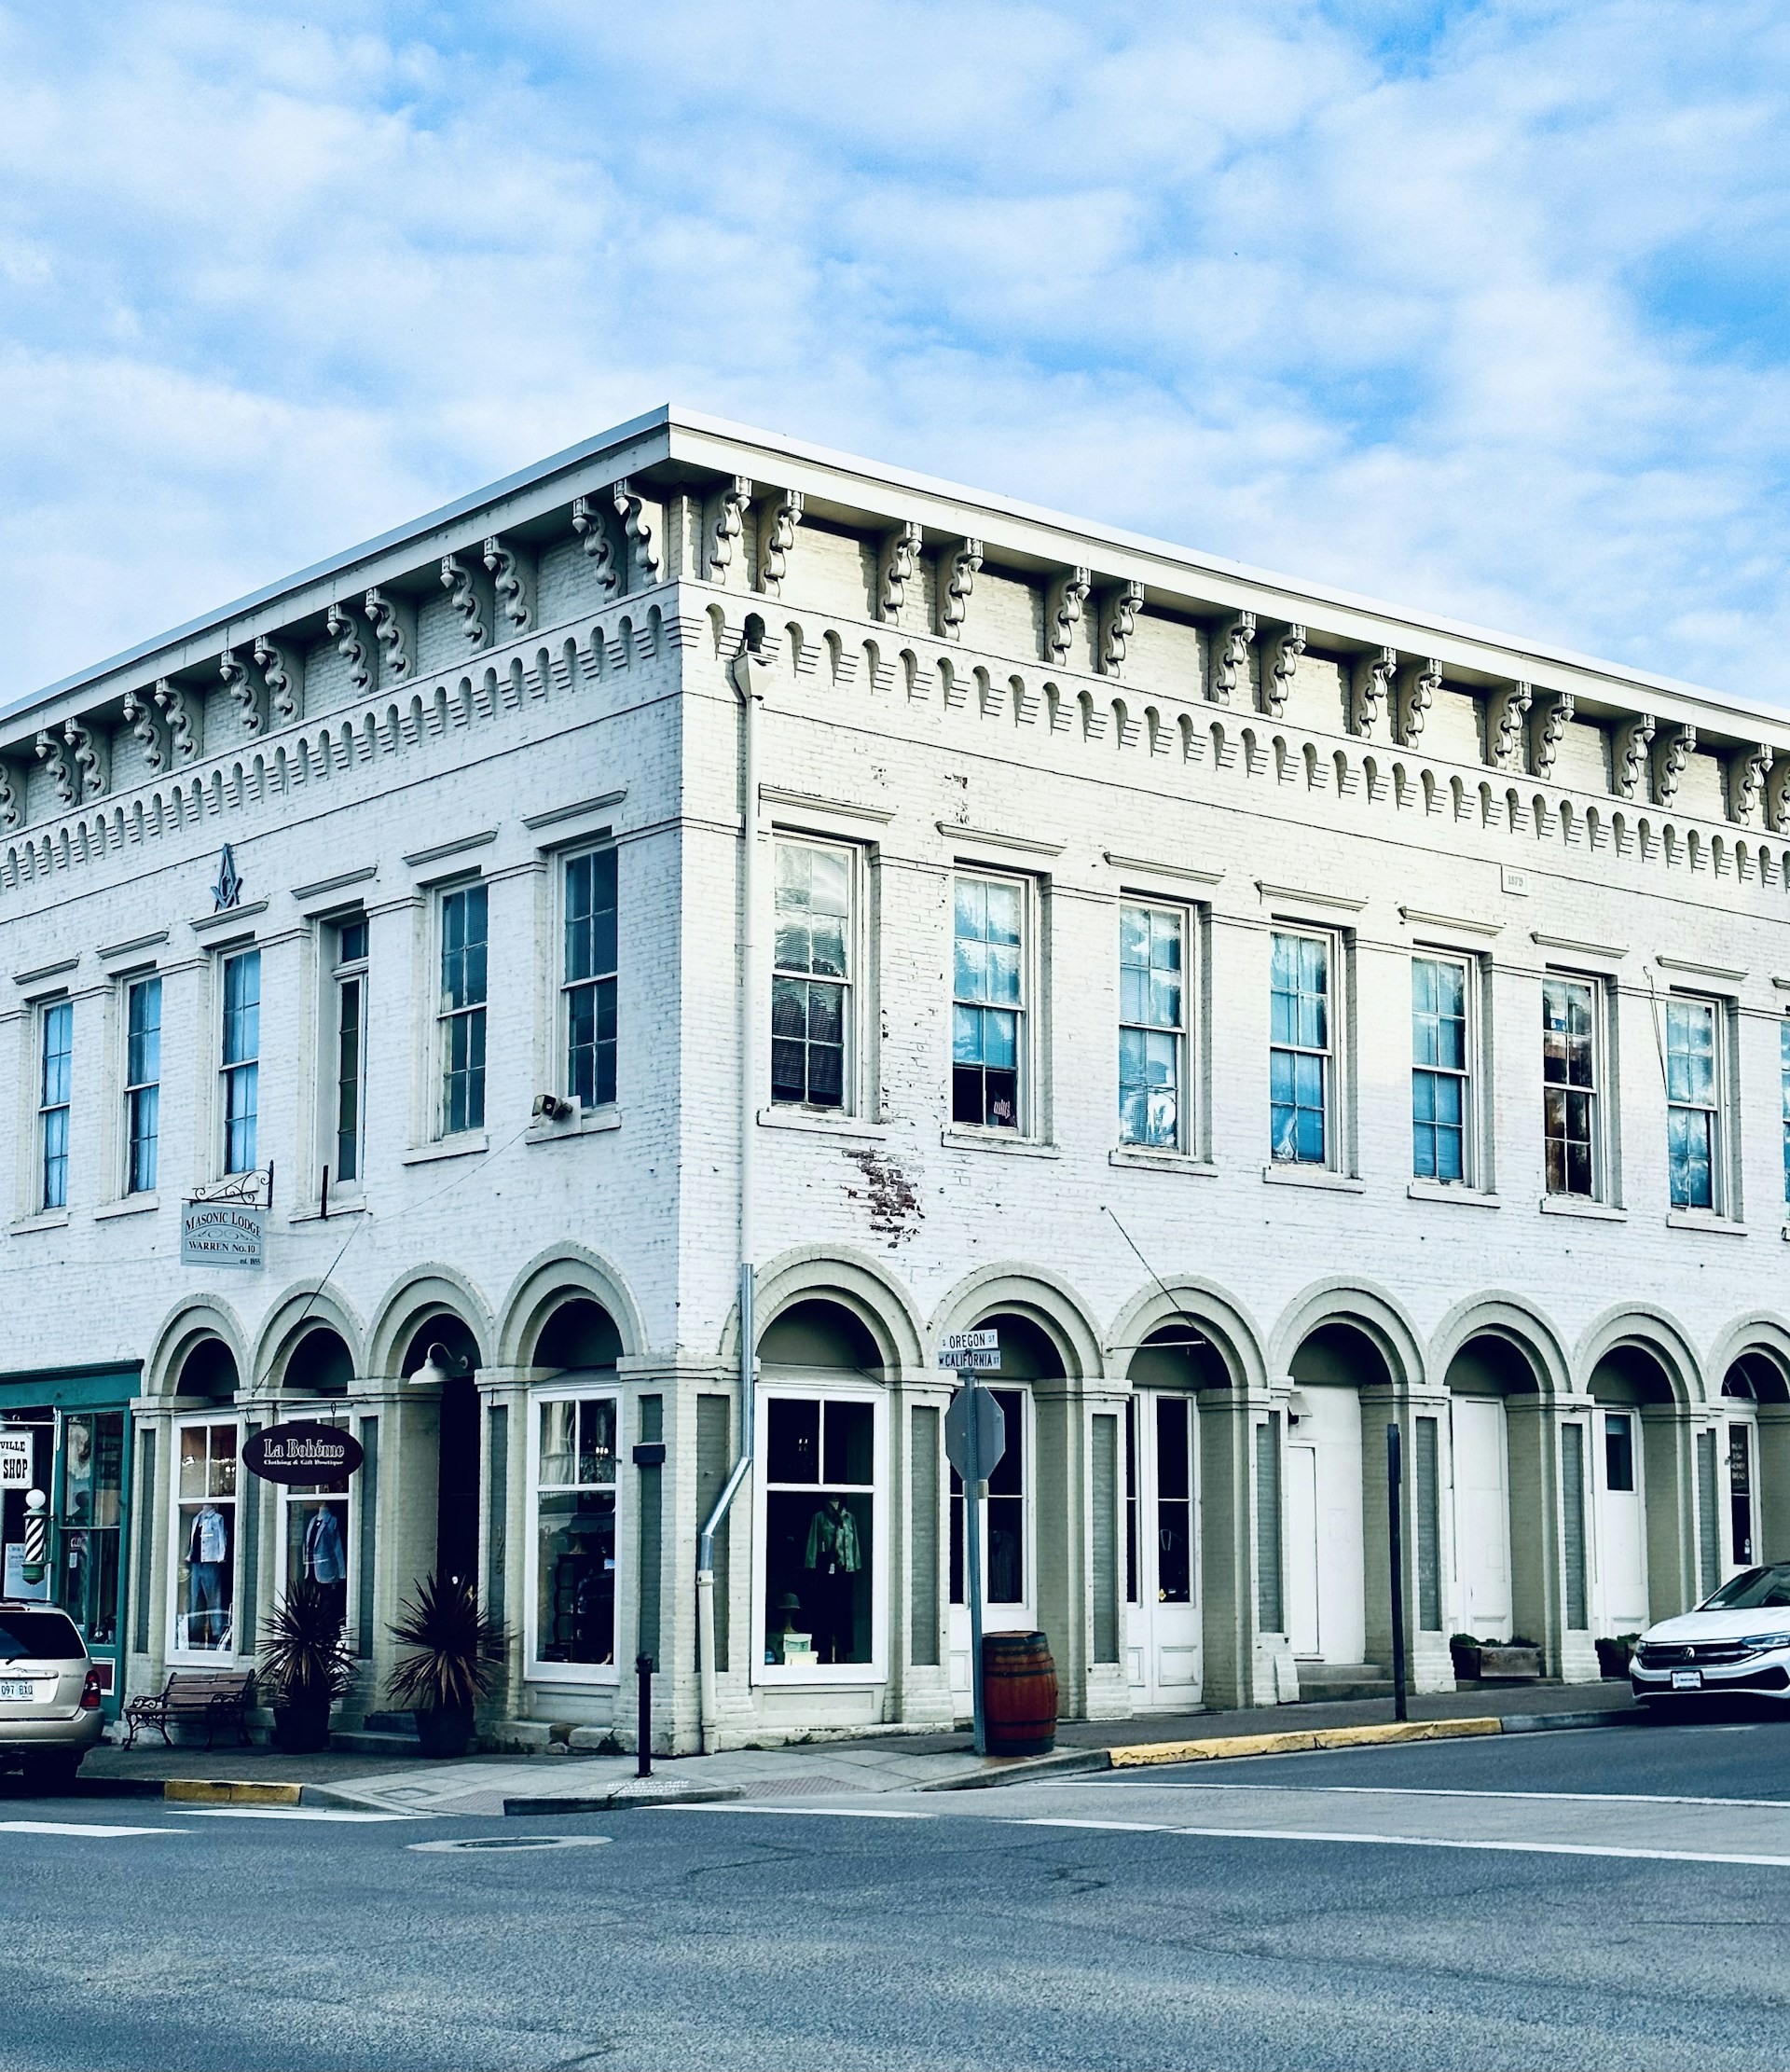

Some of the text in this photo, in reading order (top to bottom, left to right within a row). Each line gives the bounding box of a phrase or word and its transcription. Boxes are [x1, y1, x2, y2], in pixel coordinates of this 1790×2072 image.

[186, 1211, 261, 1238] MASONIC LODGE
[188, 1241, 229, 1251] WARREN
[949, 1333, 985, 1348] OREGON
[945, 1353, 992, 1367] CALIFORNIA
[264, 1438, 345, 1457] La Bohéme
[3, 1458, 28, 1479] SHOP
